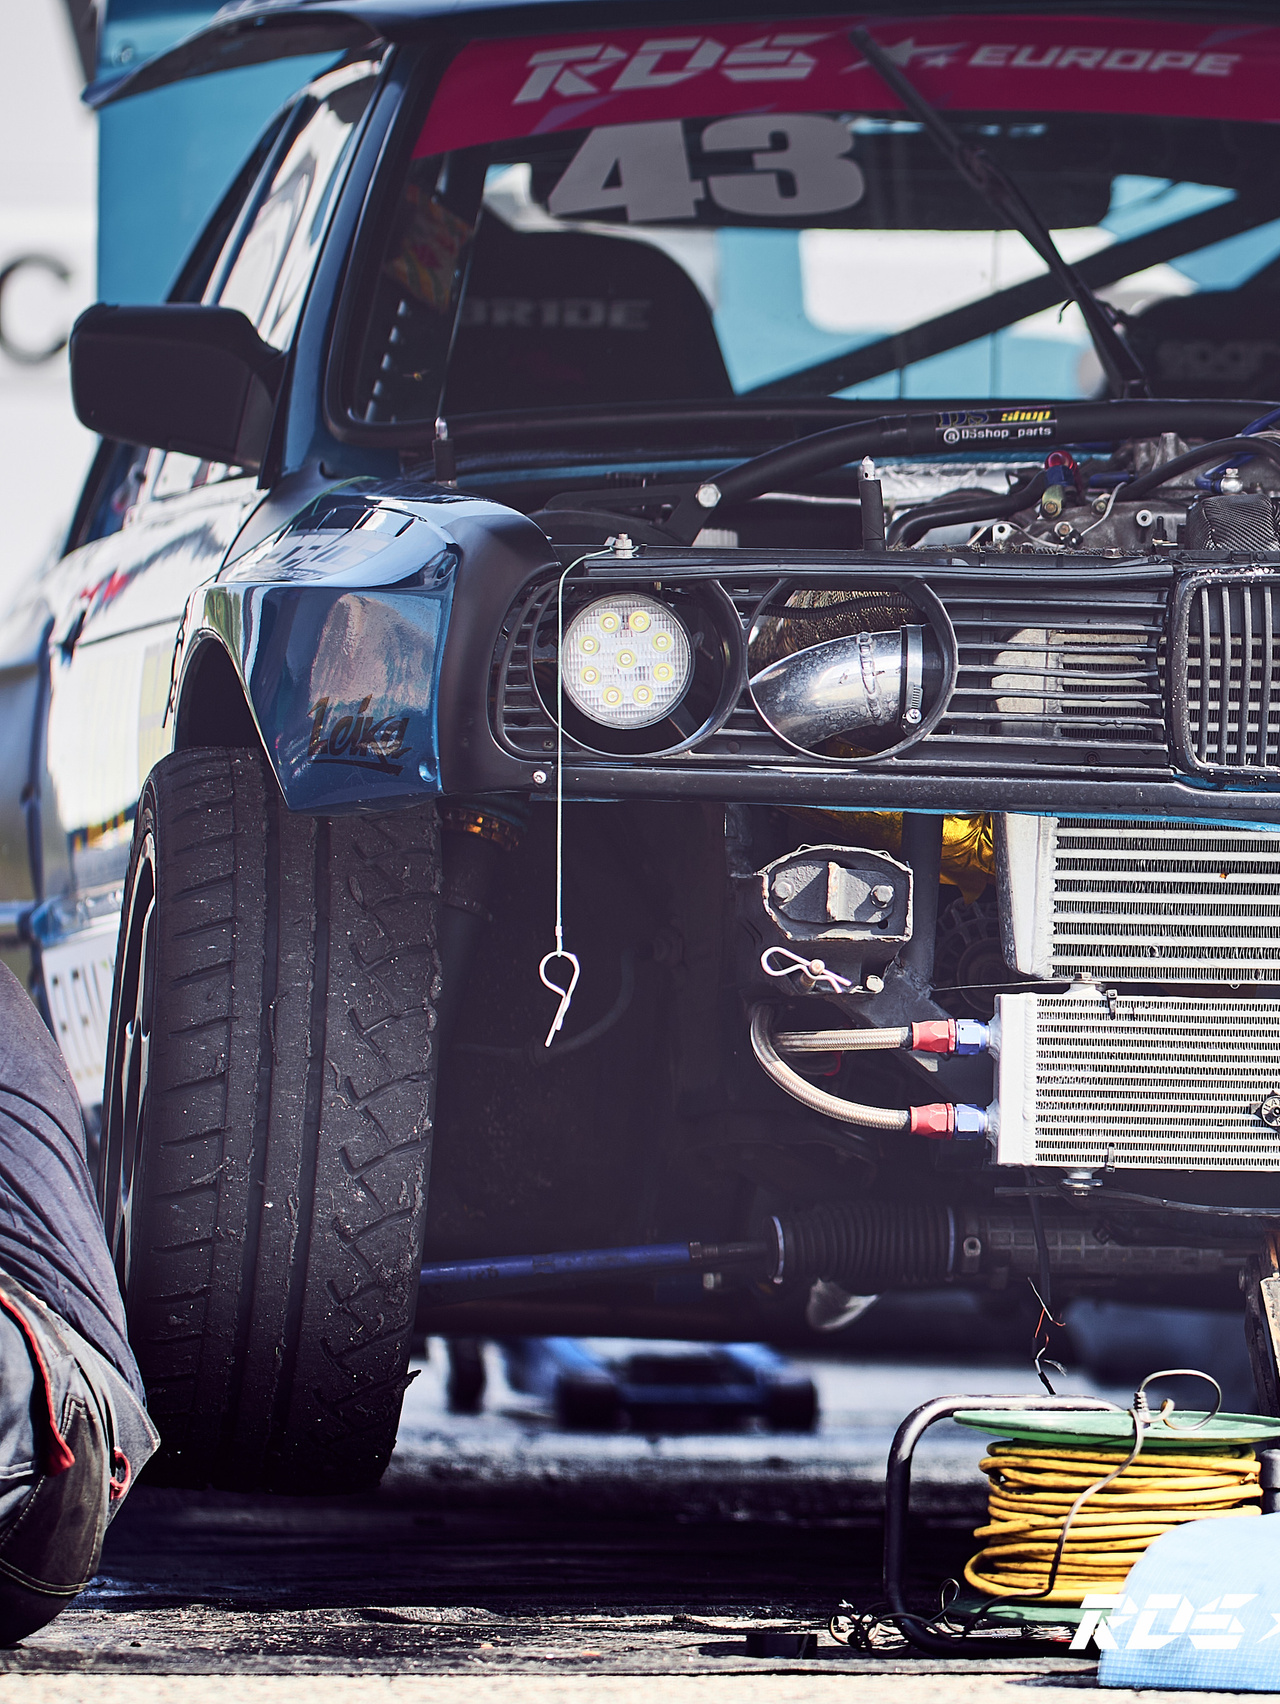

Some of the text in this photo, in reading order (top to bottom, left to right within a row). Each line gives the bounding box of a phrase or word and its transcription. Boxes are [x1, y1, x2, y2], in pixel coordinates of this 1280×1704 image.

[511, 33, 835, 105] RDS
[966, 43, 1243, 77] EUROPE
[547, 113, 865, 222] 43
